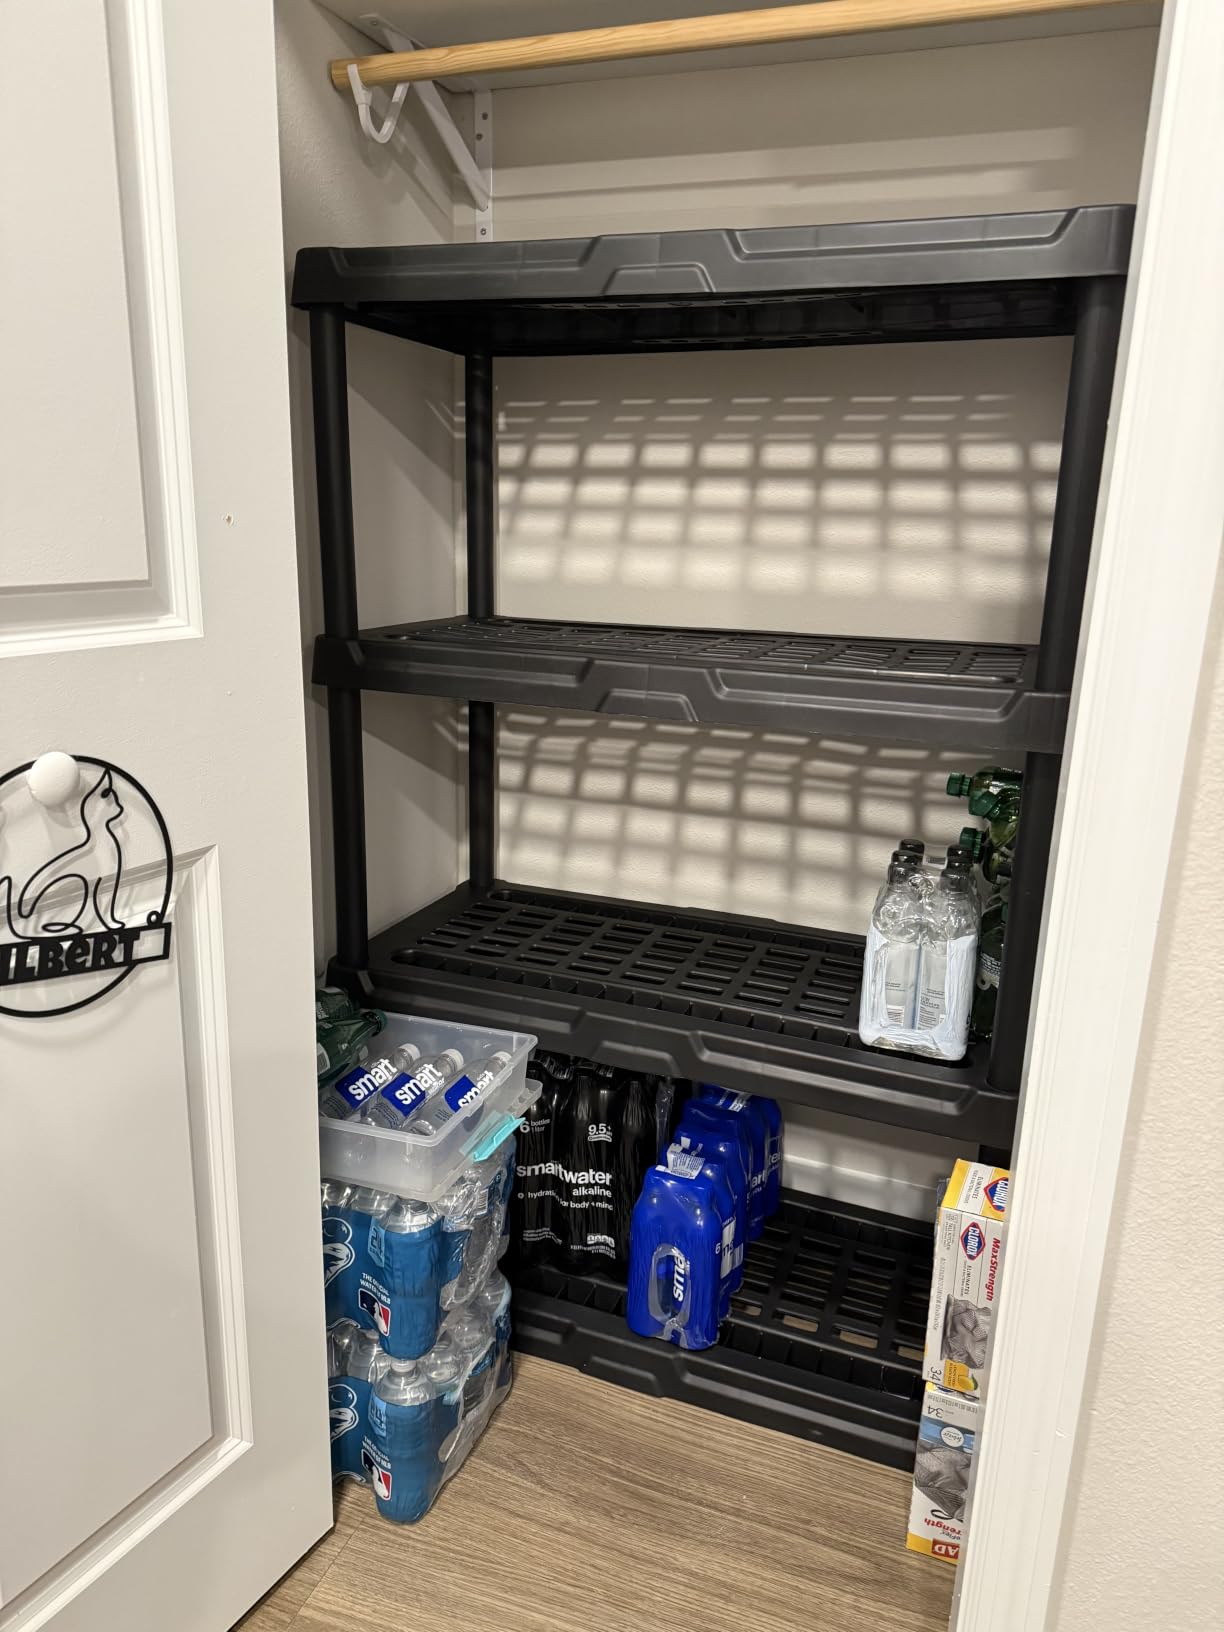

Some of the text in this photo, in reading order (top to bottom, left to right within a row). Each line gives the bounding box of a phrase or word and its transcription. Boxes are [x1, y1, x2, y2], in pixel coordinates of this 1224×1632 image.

[348, 1058, 398, 1101] smart
[395, 1062, 443, 1105] smart
[520, 1120, 530, 1133] 6
[516, 1162, 613, 1186] smartwater
[572, 1185, 613, 1198] alkaline
[570, 1200, 589, 1209] body
[715, 1242, 721, 1255] 6
[967, 1226, 980, 1257] CLOROX
[986, 1237, 1001, 1302] MaxStrength
[930, 1366, 942, 1382] 34
[927, 1404, 944, 1419] 34
